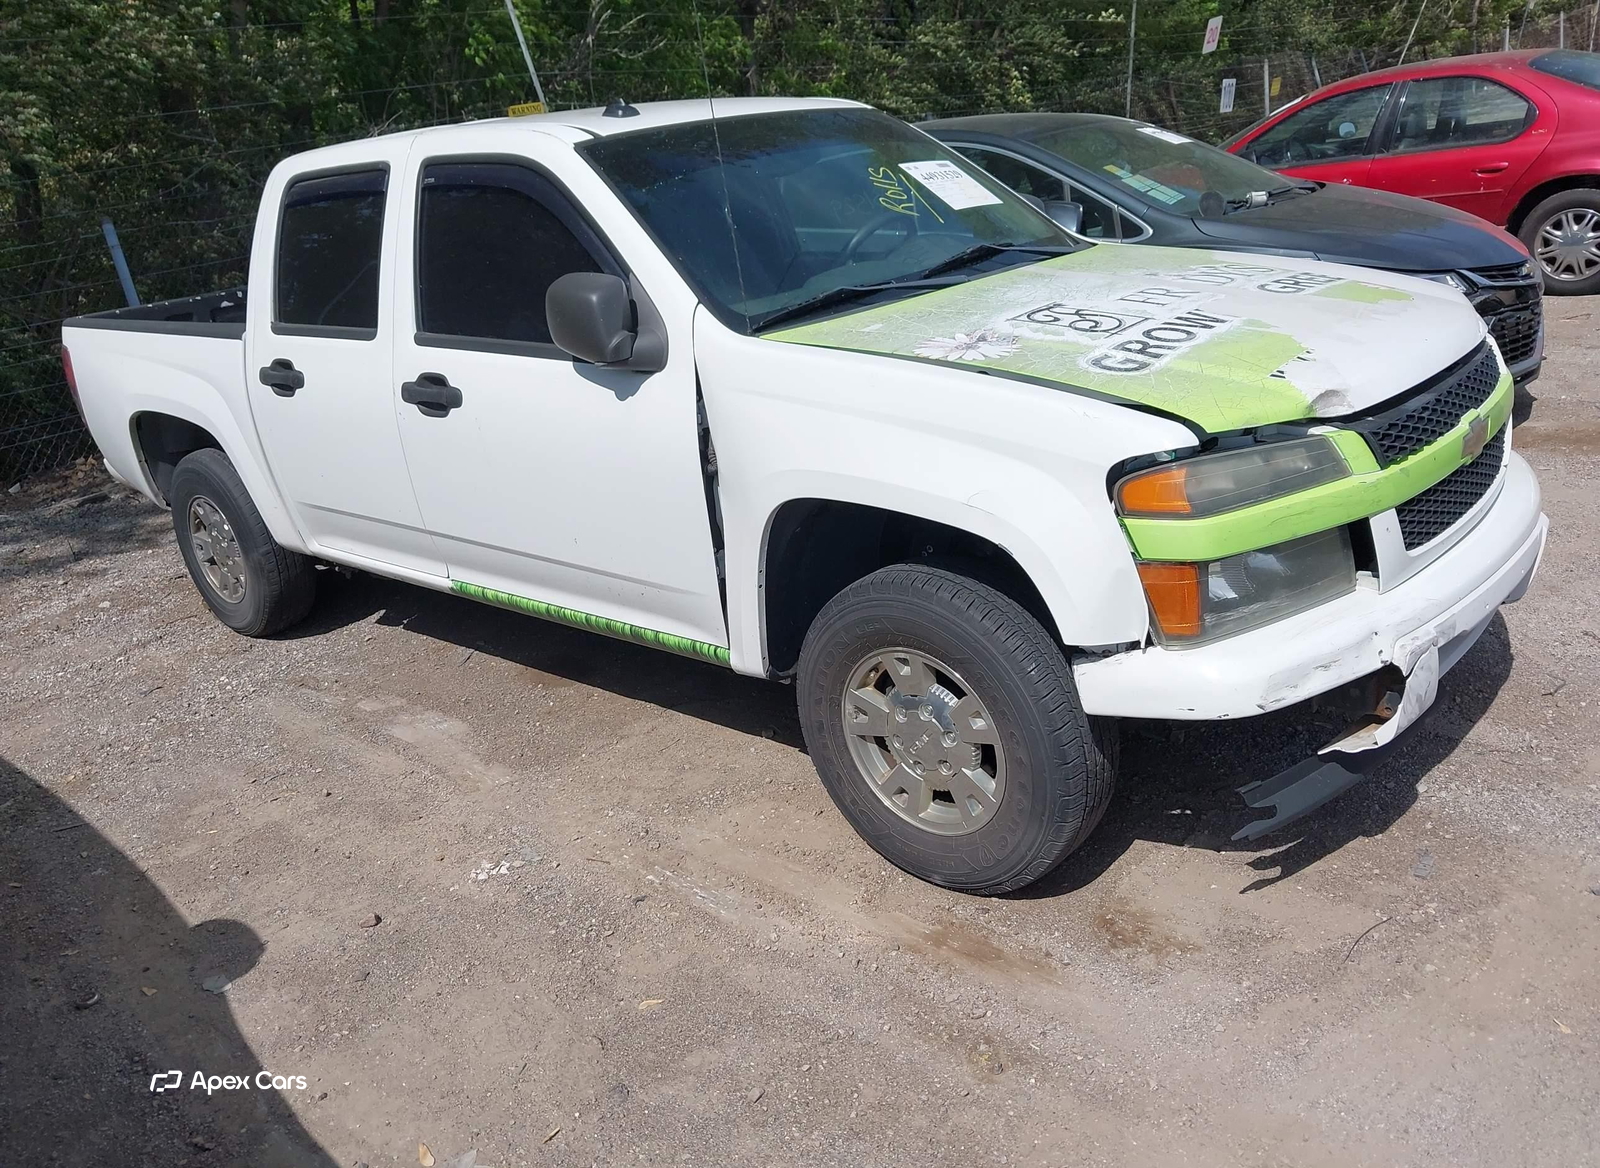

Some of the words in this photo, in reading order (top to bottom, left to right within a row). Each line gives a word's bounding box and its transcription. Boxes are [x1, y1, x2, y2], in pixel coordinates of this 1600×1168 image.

[1206, 26, 1219, 45] 20
[510, 104, 542, 115] WARNING
[920, 169, 964, 183] 44931529
[1088, 308, 1229, 373] GROW
